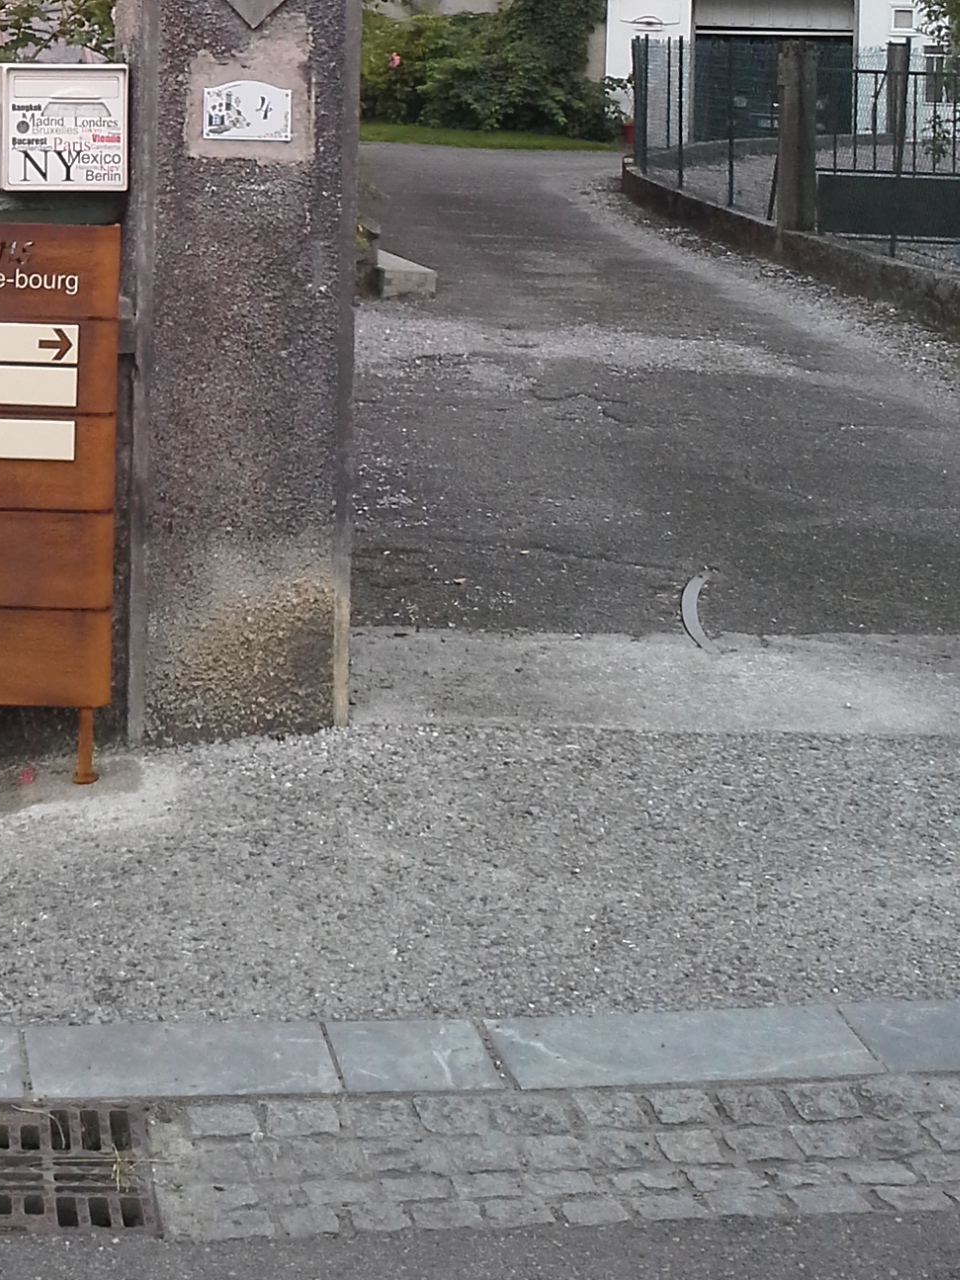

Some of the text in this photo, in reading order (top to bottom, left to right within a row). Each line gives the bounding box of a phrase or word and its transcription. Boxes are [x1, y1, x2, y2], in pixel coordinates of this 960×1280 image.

[11, 103, 42, 112] Bangkok
[255, 95, 273, 120] 4
[29, 113, 64, 127] Madrid
[74, 116, 119, 128] Londres
[32, 125, 80, 135] Bruxelles
[11, 136, 47, 146] Bucarest
[53, 135, 91, 151] Paris
[67, 151, 121, 165] Mexico
[19, 150, 82, 182] NY
[85, 169, 121, 182] Berlin
